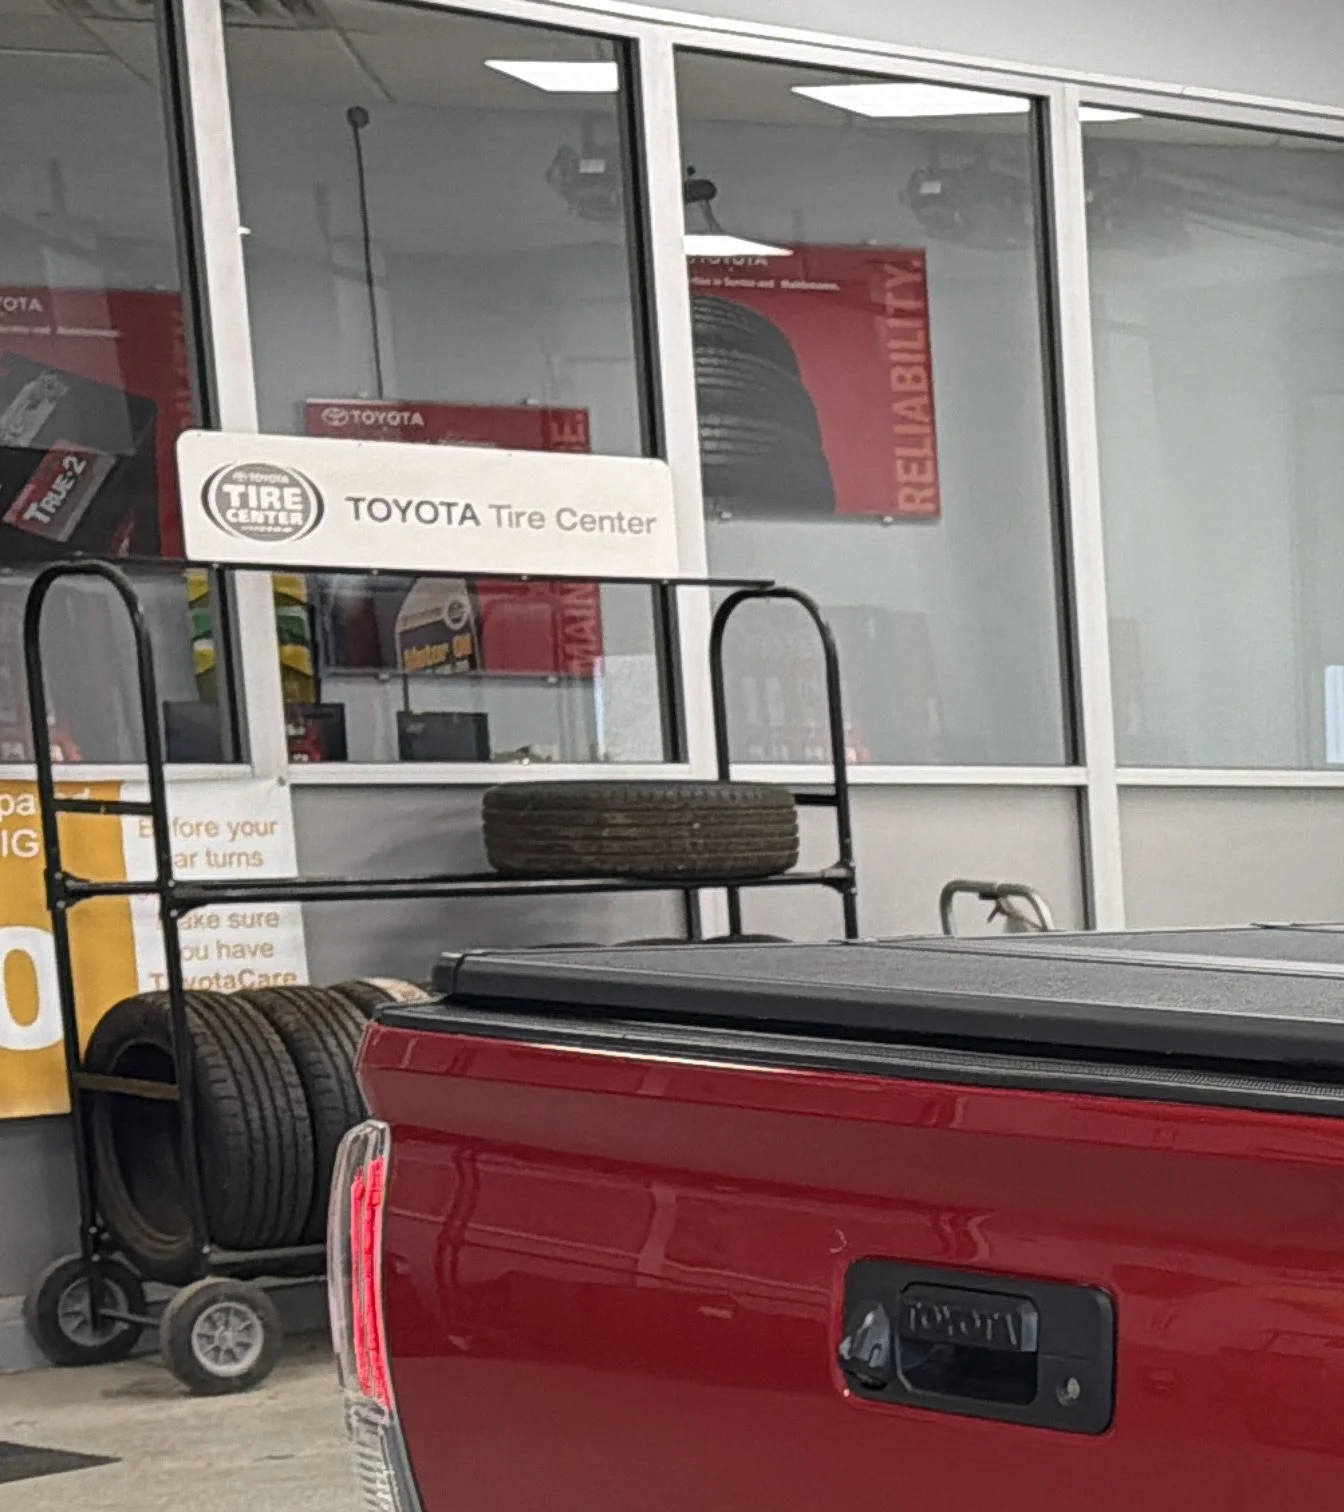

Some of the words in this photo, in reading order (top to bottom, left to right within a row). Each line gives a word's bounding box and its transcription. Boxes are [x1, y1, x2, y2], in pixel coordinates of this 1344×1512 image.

[350, 409, 424, 427] TOYOTA
[222, 484, 304, 510] TIRE
[226, 508, 304, 526] CENTER
[344, 496, 481, 526] TOYOTA
[488, 503, 546, 530] Tire
[555, 506, 657, 535] Center
[138, 817, 219, 838] Bfore
[227, 820, 278, 842] your
[205, 849, 264, 868] turns
[227, 911, 280, 929] sure
[216, 940, 274, 958] have
[149, 968, 298, 992] TyotaCare
